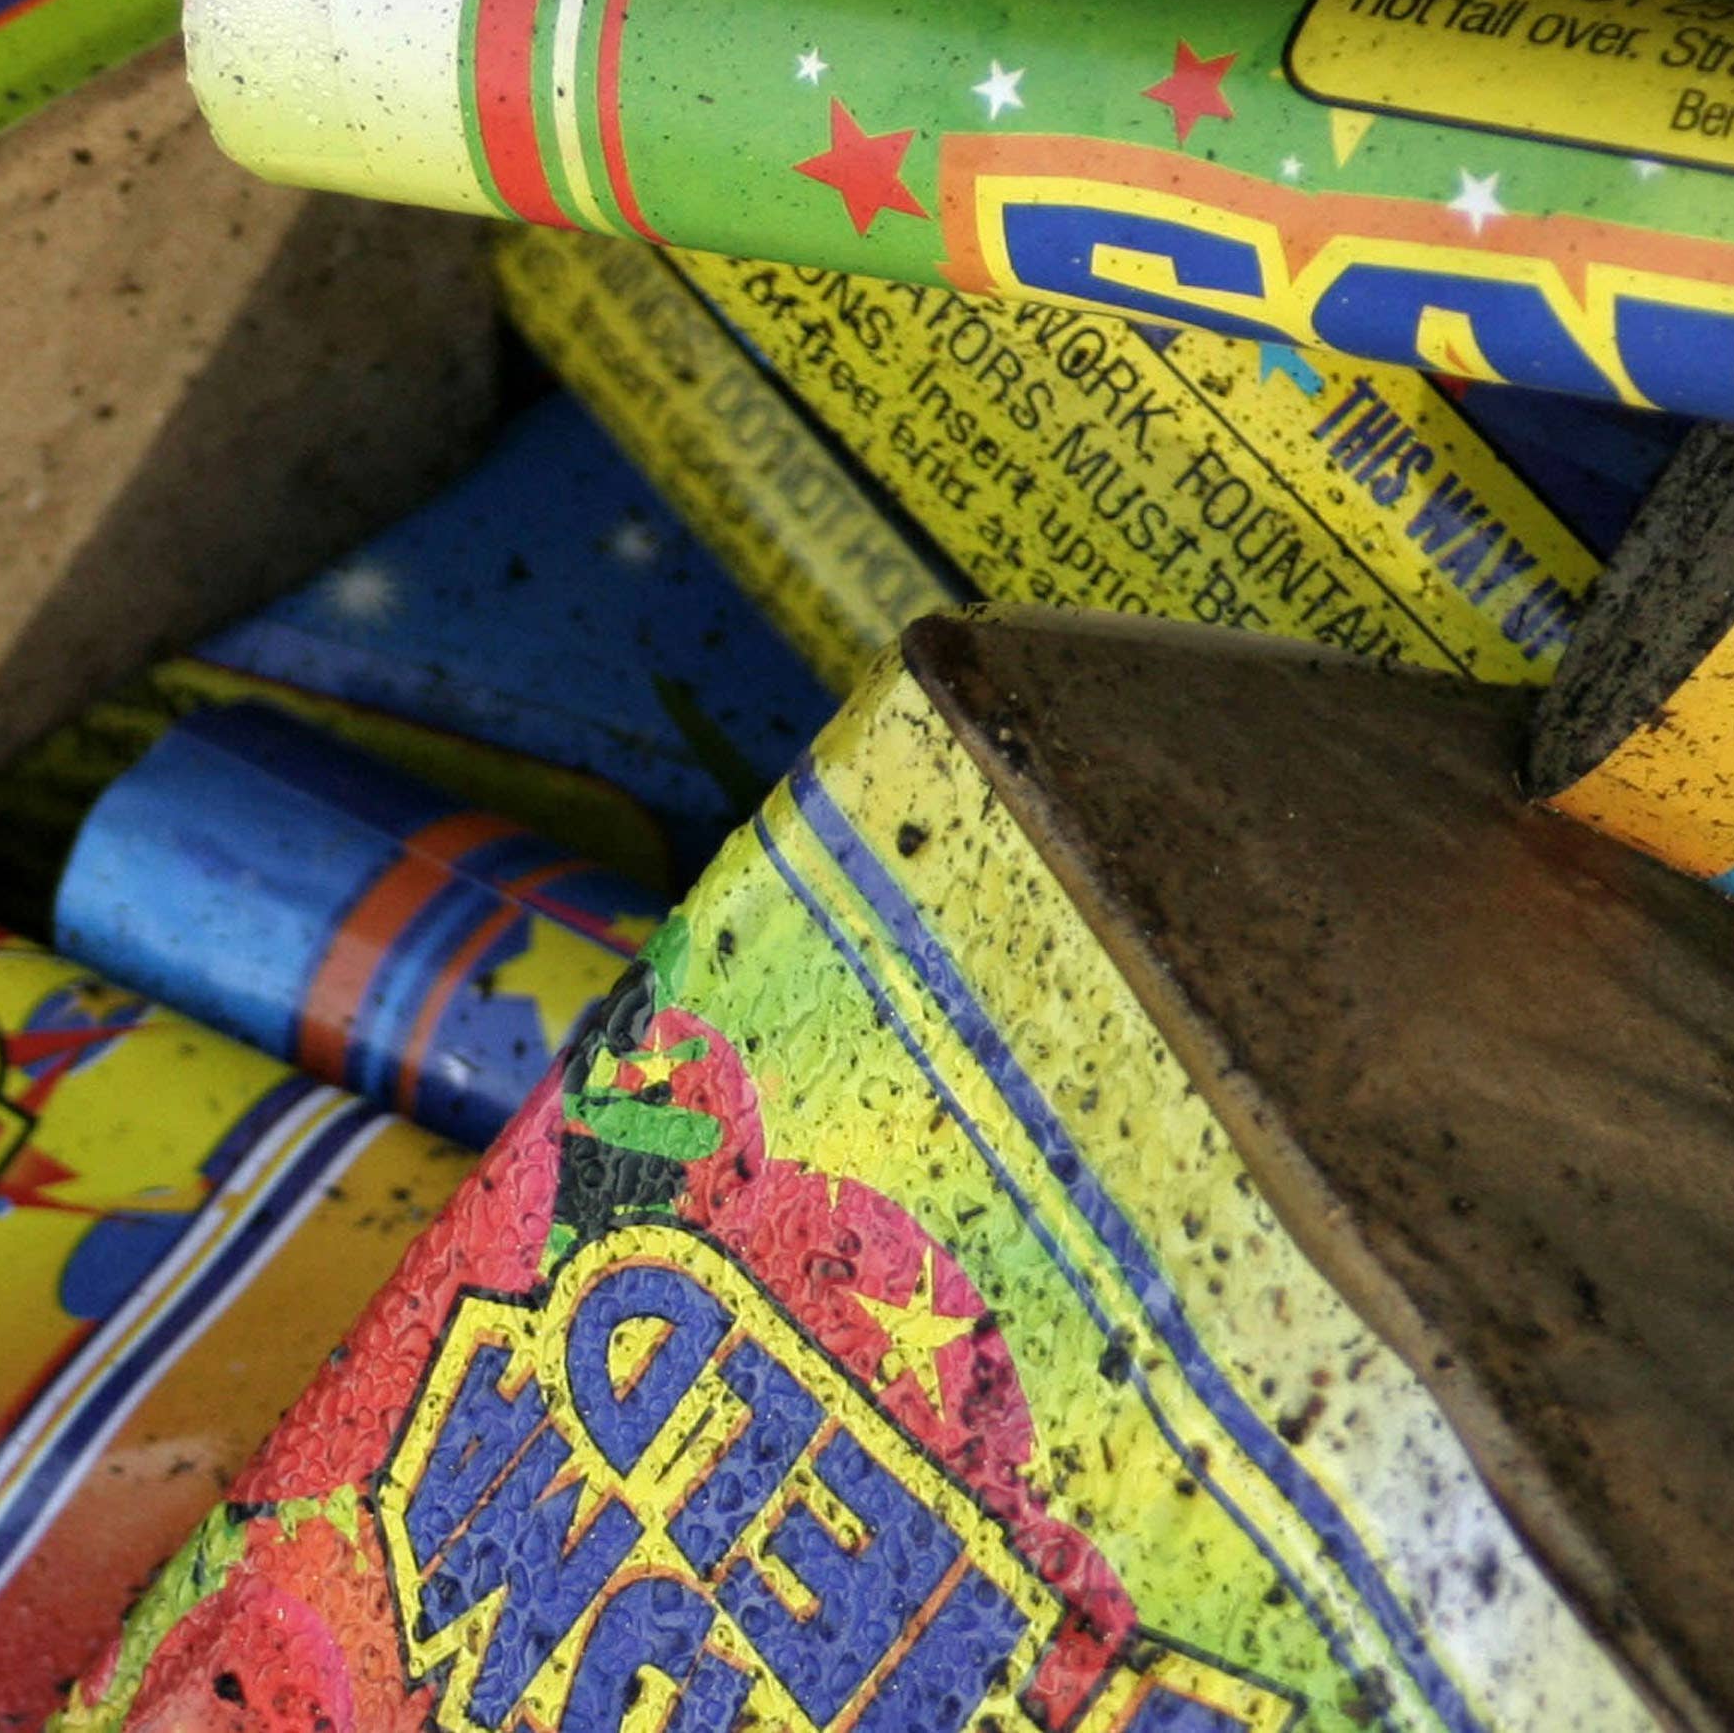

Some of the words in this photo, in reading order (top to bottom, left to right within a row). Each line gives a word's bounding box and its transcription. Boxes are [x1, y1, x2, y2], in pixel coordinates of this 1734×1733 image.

[1528, 9, 1651, 61] over.
[786, 317, 887, 425] free
[899, 353, 1050, 512] Insert
[1043, 423, 1210, 592] MUST
[1302, 375, 1443, 510] THIS
[1393, 471, 1538, 611] WAY
[1492, 574, 1591, 667] UP
[567, 1269, 1035, 1733] IELD
